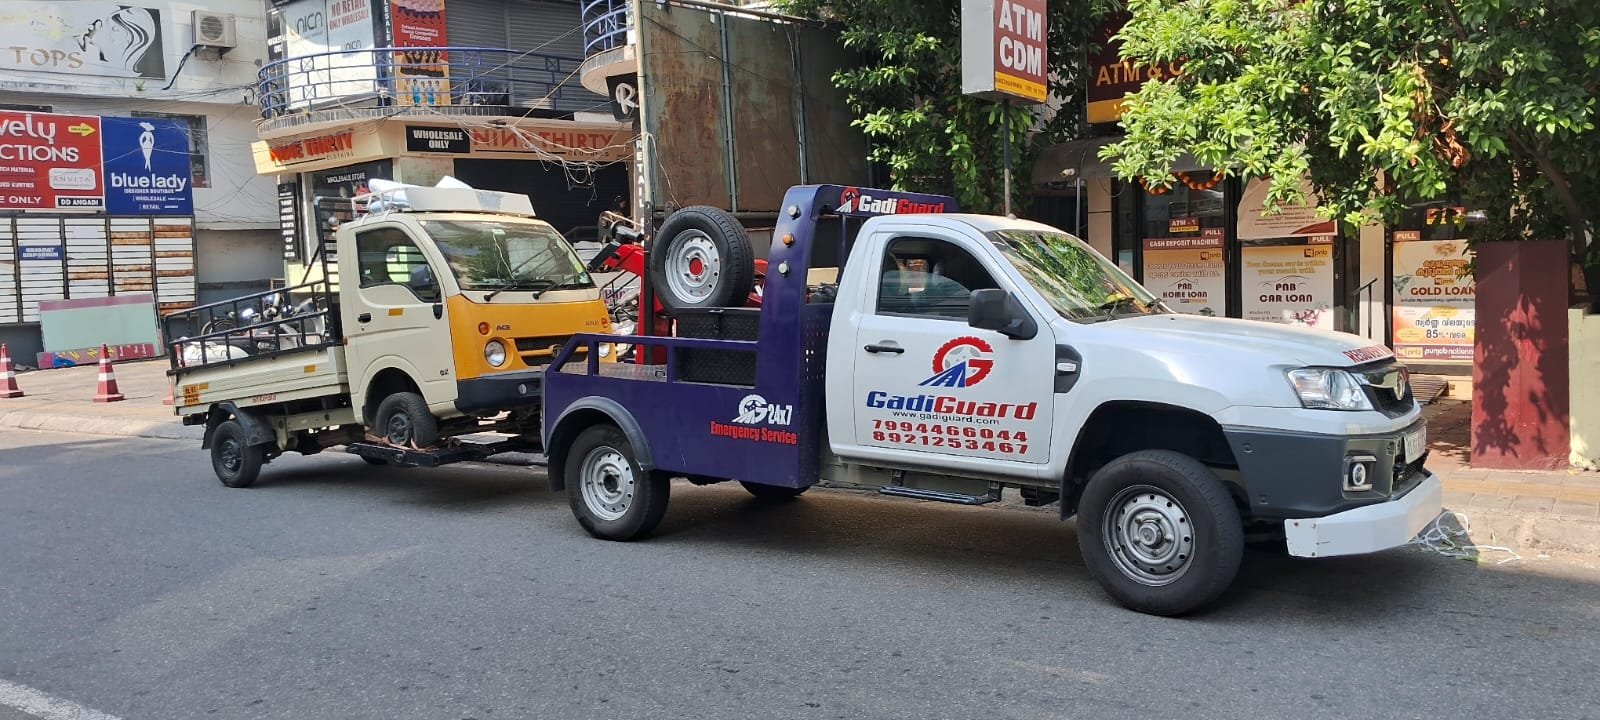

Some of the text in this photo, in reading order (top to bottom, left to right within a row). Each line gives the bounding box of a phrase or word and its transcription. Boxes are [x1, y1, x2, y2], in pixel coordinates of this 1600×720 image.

[998, 0, 1042, 42] ATM
[9, 46, 84, 69] TOPS
[1000, 36, 1042, 77] CDM
[1096, 61, 1140, 87] ATM
[413, 130, 463, 140] WHOLESALE
[539, 132, 613, 150] THIRTY
[428, 140, 449, 149] ONLY
[9, 195, 42, 204] ONLY
[858, 195, 945, 214] GadiGuard
[1149, 240, 1165, 248] CASH
[1397, 232, 1417, 240] PULL
[1276, 283, 1297, 292] PNB
[1410, 287, 1442, 296] GOLD
[1260, 294, 1313, 303] CAR LOAN
[767, 403, 793, 426] 24x7
[866, 391, 1038, 420] GadiGuard
[892, 410, 1000, 425] www.gadiguard.com
[710, 420, 798, 445] Emergency Service
[872, 419, 1028, 442] 7994466044
[872, 431, 1028, 454] 8921253467
